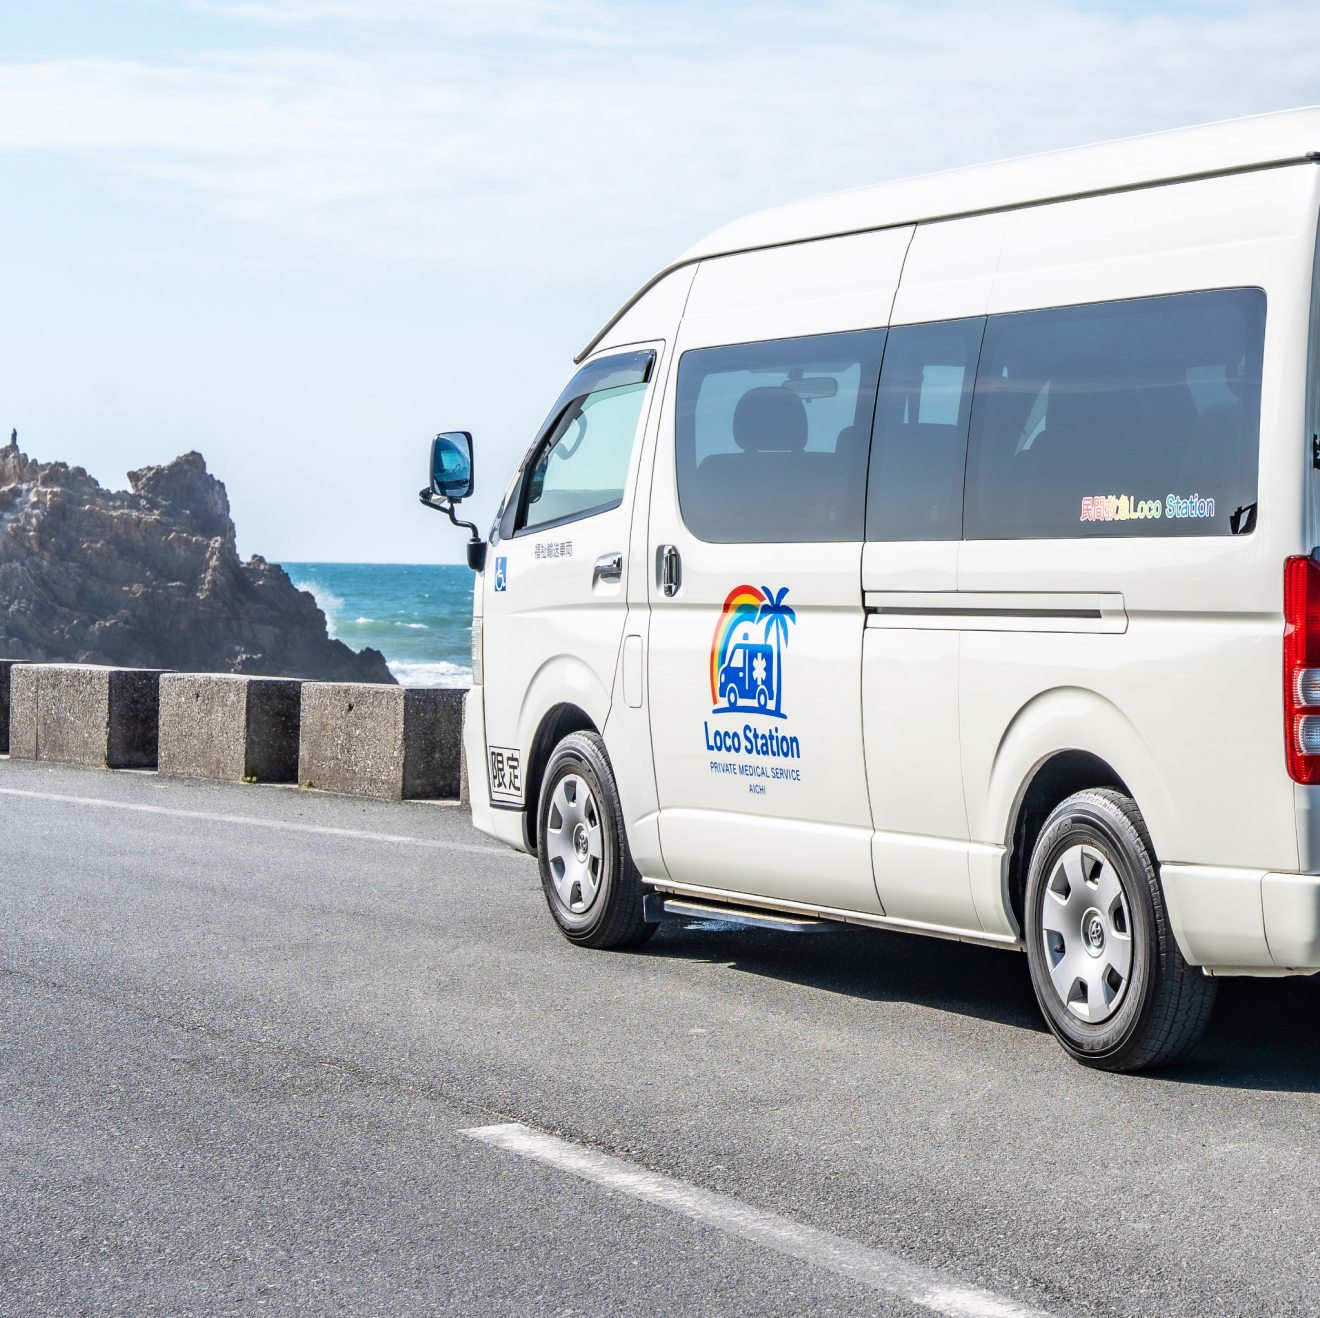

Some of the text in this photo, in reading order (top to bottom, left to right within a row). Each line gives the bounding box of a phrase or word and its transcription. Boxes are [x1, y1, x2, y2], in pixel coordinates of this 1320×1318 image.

[1165, 493, 1214, 518] Station
[534, 541, 573, 559] 福祉輸送車両
[704, 721, 800, 758] Loco Station
[491, 751, 520, 791] 限定
[710, 761, 801, 781] PRIVATE MEDICAL SERVICE
[749, 783, 767, 795] AICHI
